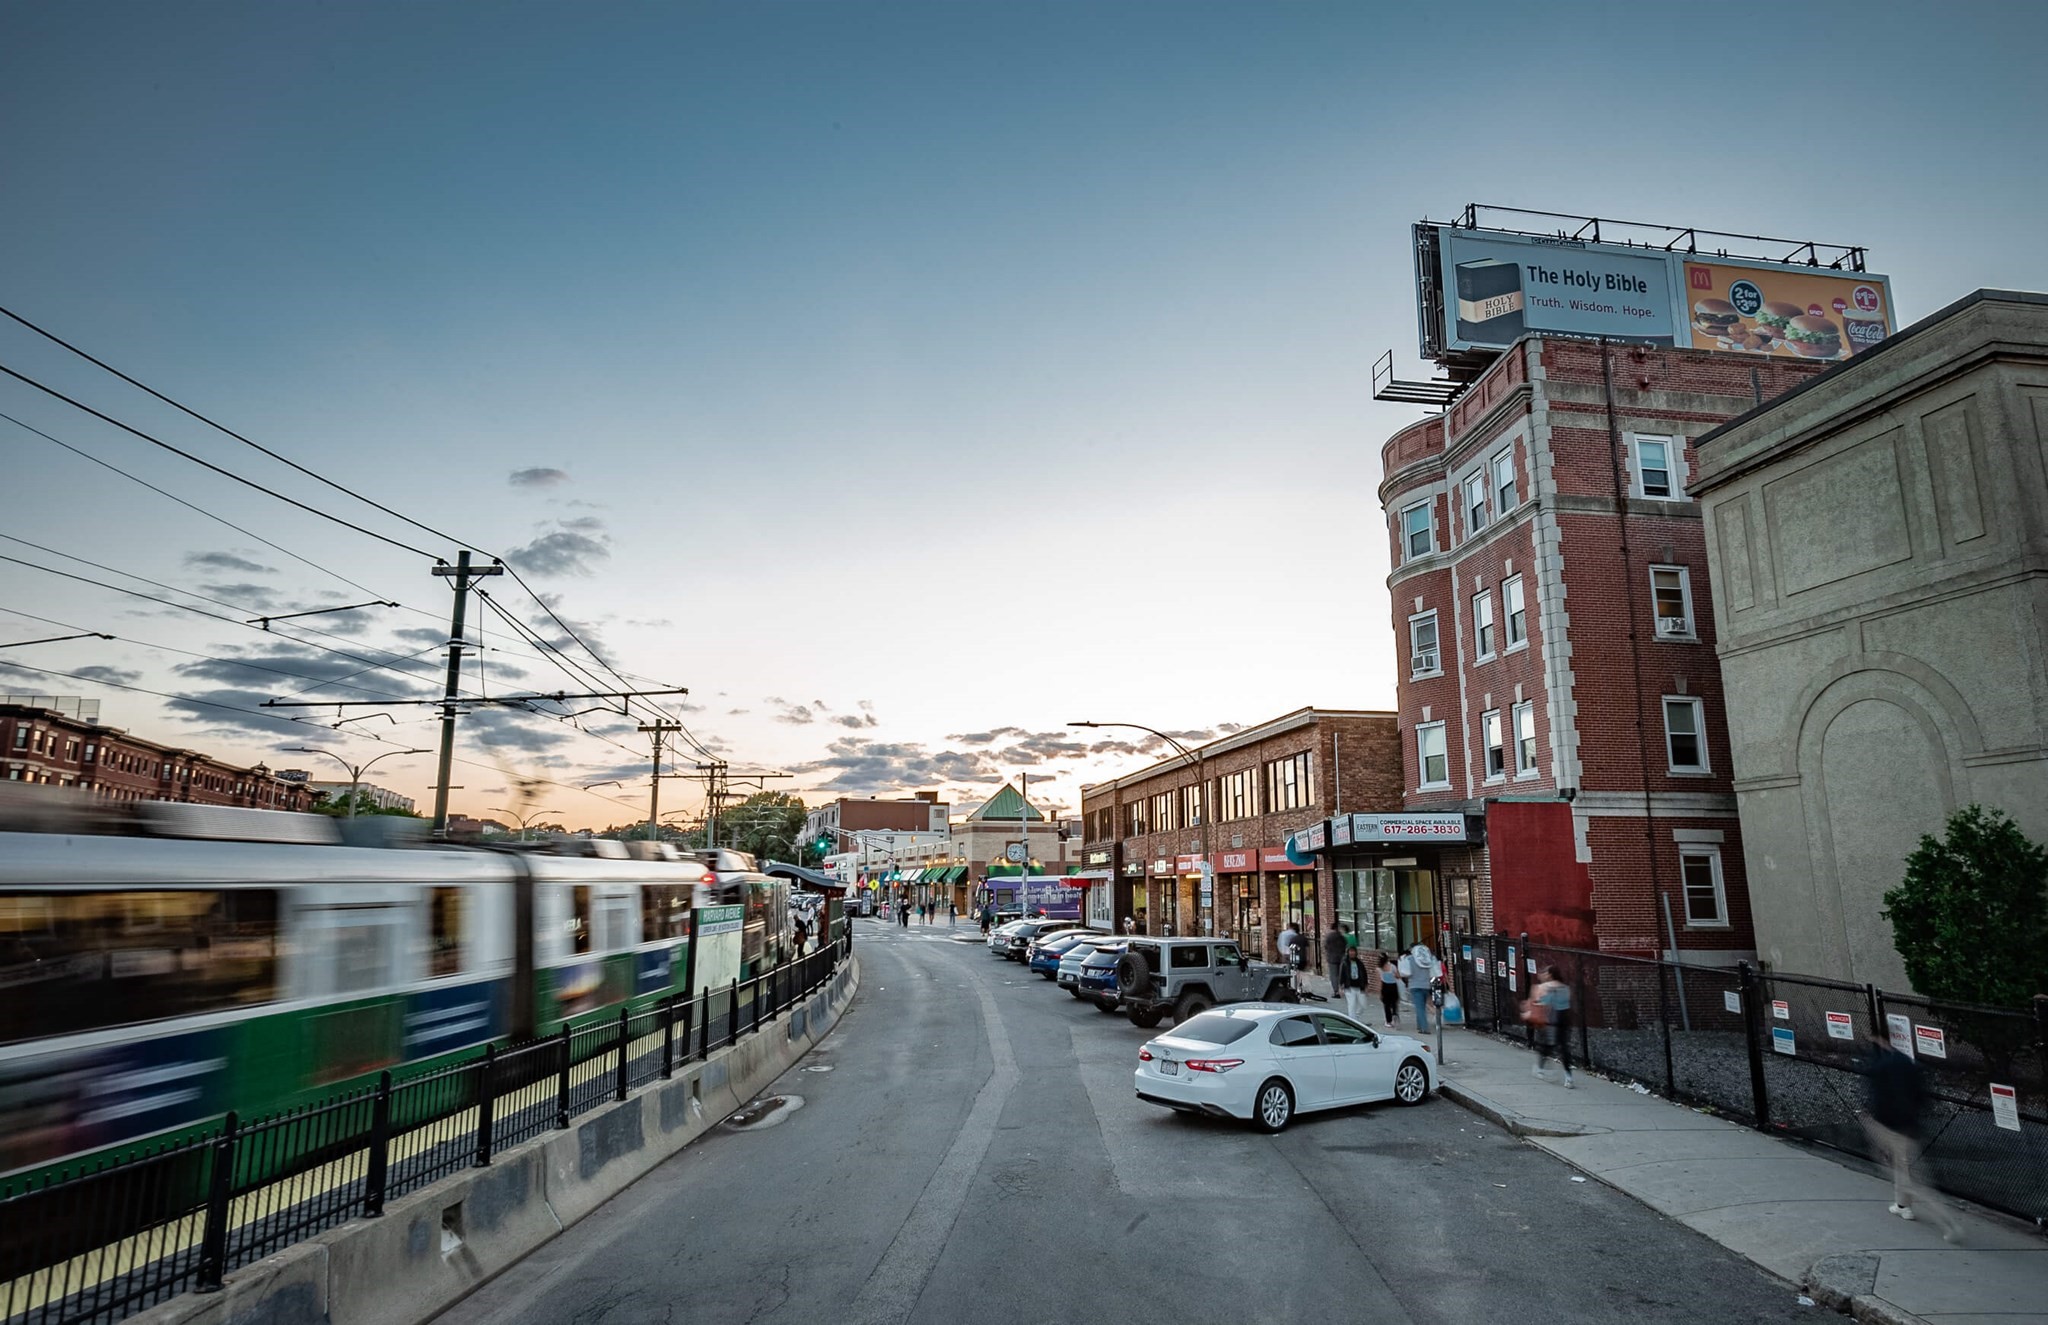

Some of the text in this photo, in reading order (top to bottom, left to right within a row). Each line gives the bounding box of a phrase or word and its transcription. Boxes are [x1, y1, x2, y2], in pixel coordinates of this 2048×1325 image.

[1527, 265, 1648, 293] The Holy Bible
[1734, 287, 1758, 299] 2 for
[1485, 294, 1514, 310] HOLY
[1485, 302, 1516, 318] BIBLE
[1529, 295, 1656, 319] Truth. Wisdom. Hope.
[1847, 321, 1885, 339] Coca-Cola
[1384, 825, 1461, 835] 617-286-3830
